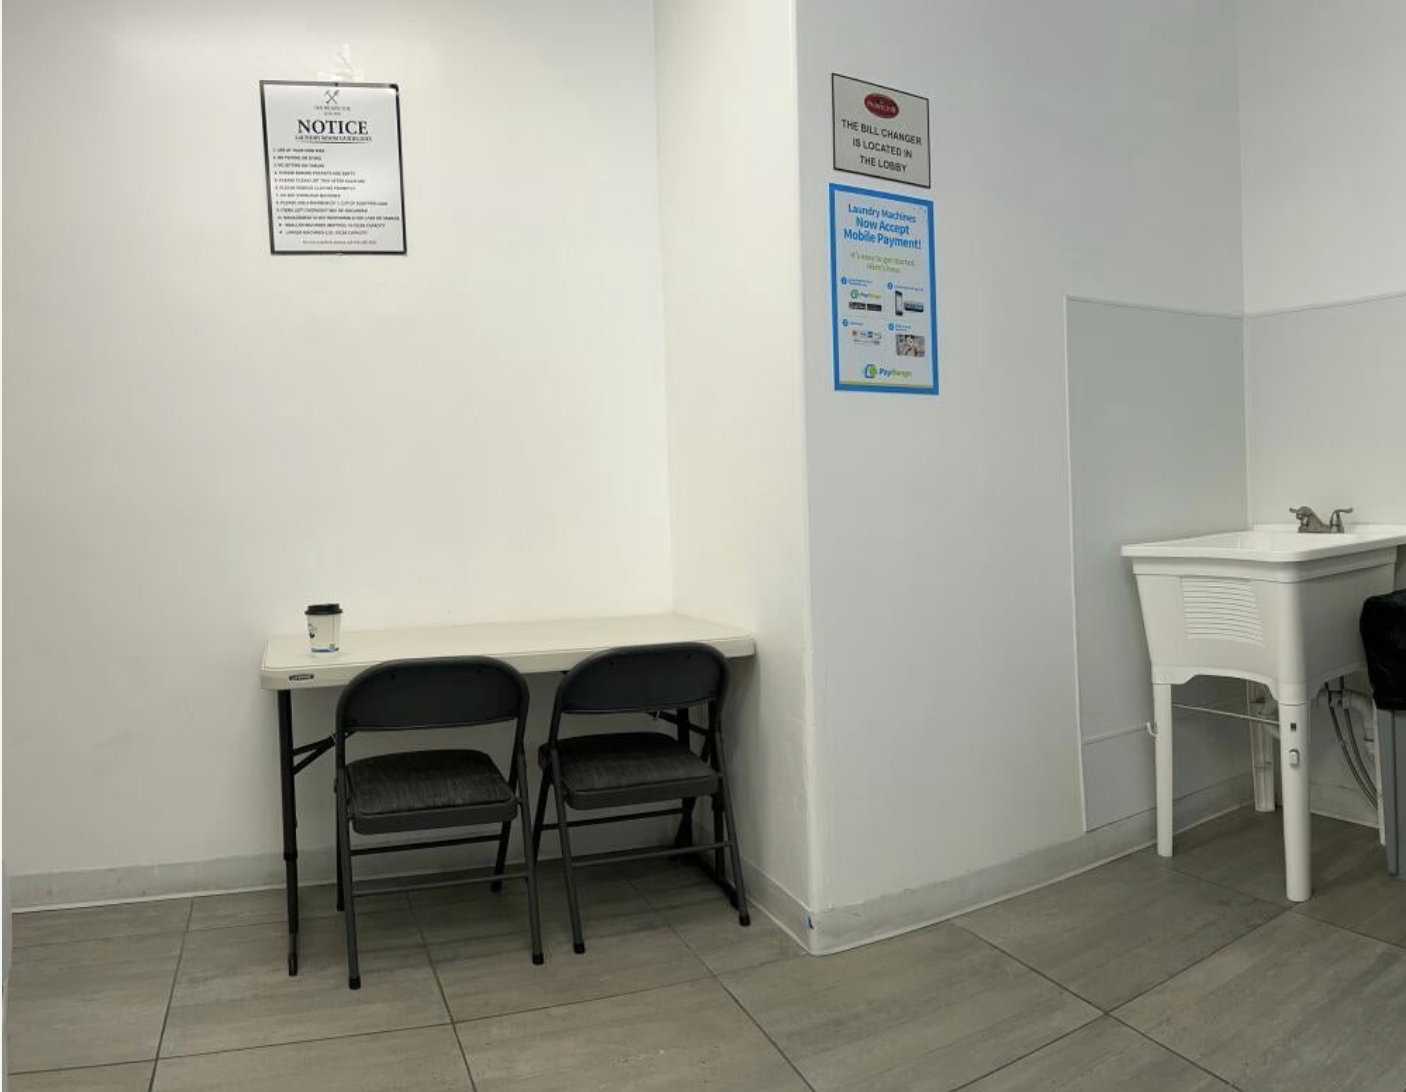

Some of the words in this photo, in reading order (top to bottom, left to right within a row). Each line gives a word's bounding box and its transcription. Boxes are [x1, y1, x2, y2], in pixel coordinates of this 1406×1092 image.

[297, 119, 368, 135] NOTICE
[842, 119, 858, 132] THE
[861, 124, 879, 136] BILL
[881, 129, 922, 146] CHANGER
[853, 138, 860, 148] IS
[863, 141, 902, 157] LOCATED
[904, 150, 912, 158] IN
[860, 155, 876, 167] THE
[878, 159, 907, 173] LOBBY
[848, 204, 880, 218] Laundry
[882, 209, 916, 222] Machines
[856, 216, 878, 229] Now
[880, 220, 910, 236] Accept
[844, 228, 876, 242] Mobile
[878, 233, 922, 250] Payment!
